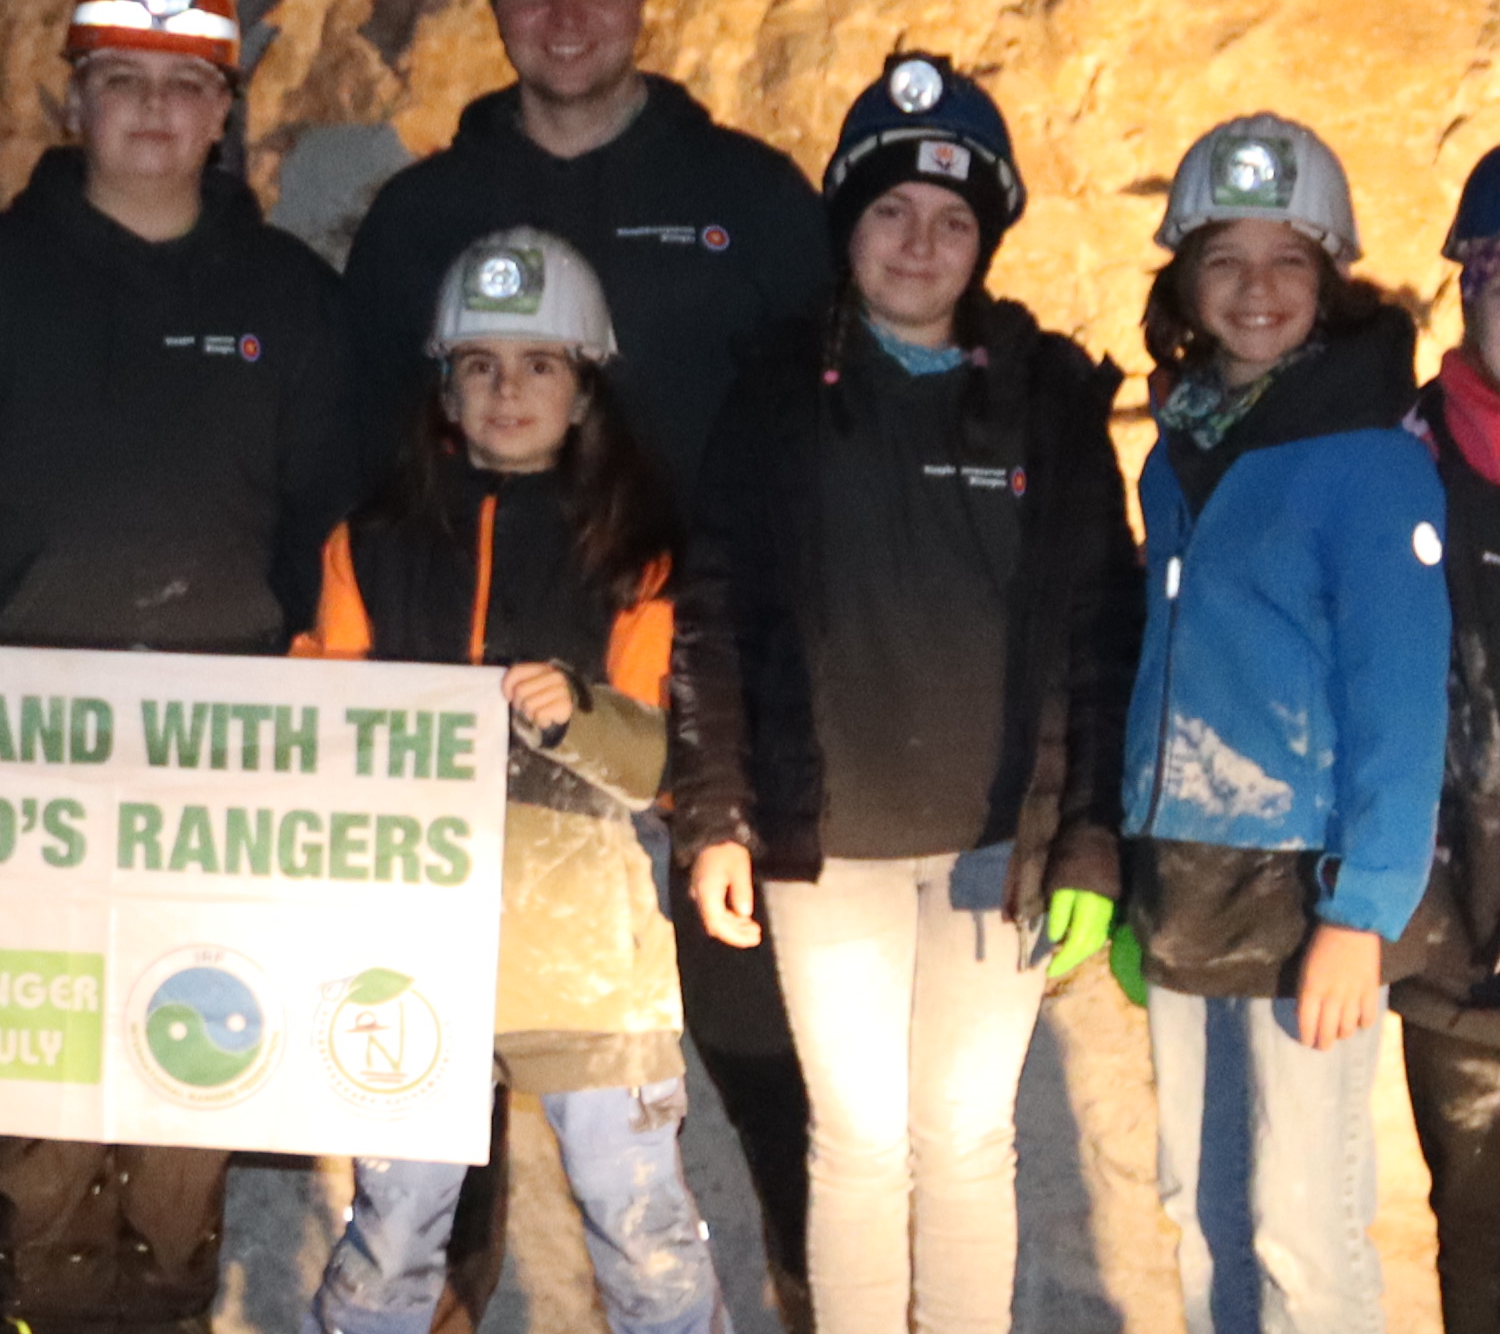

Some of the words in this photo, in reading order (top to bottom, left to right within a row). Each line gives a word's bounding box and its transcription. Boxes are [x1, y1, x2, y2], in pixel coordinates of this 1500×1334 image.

[140, 699, 319, 774] WITH
[345, 707, 478, 781] THE
[116, 801, 473, 887] RANGERS
